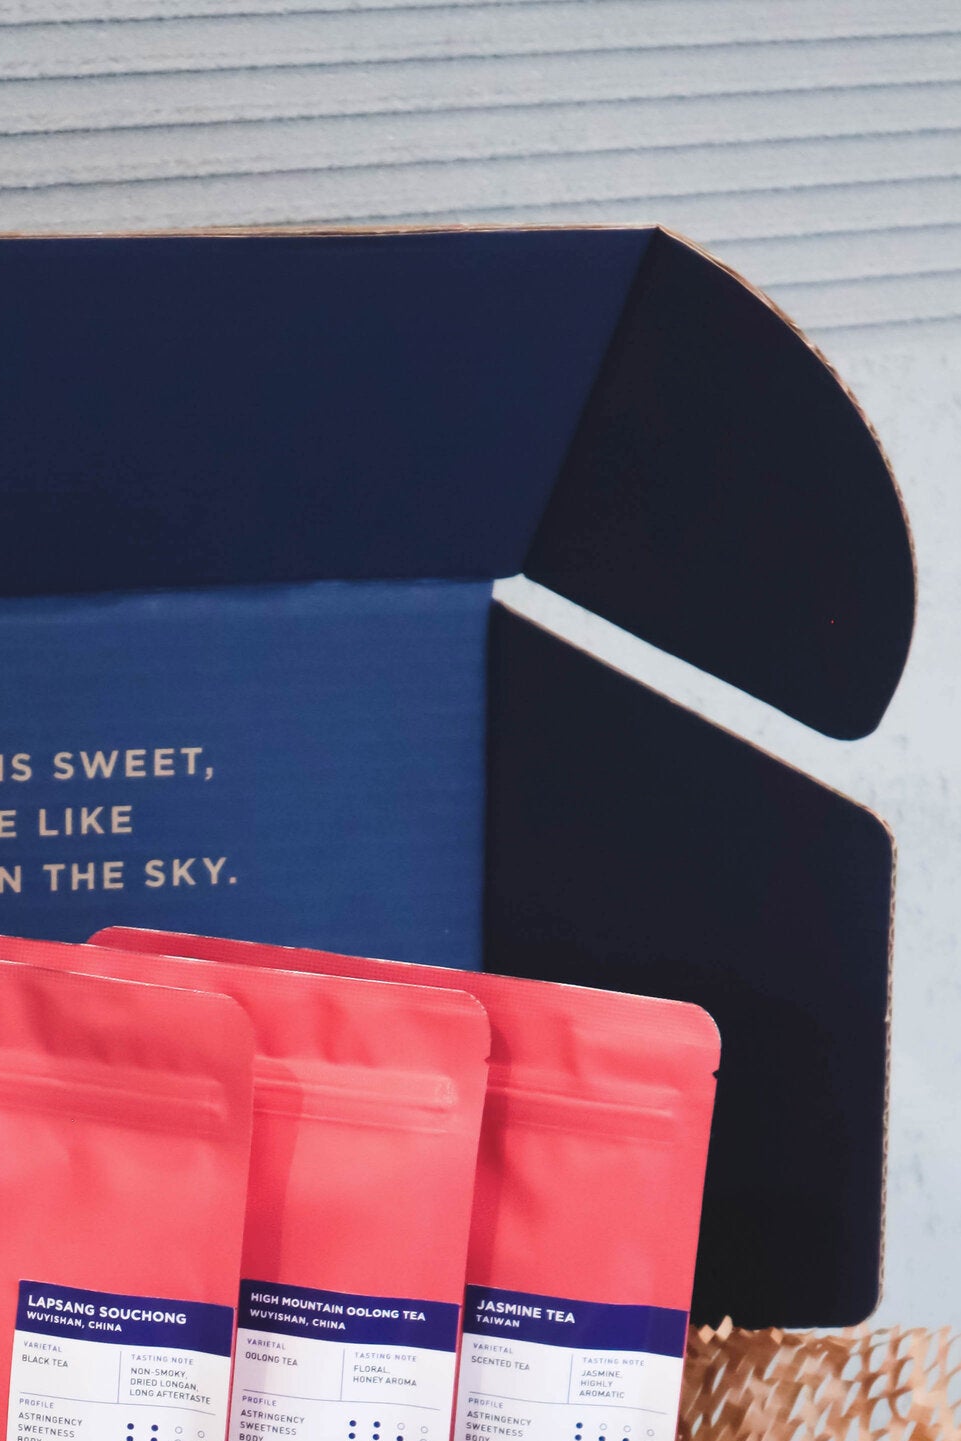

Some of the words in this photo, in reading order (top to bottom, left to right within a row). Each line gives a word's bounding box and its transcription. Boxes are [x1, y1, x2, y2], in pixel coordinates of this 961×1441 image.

[54, 747, 213, 781] SWEET,
[39, 805, 132, 836] LIKE
[43, 861, 124, 891] THE
[145, 857, 237, 887] SKY.
[28, 1295, 95, 1316] LAPSANG
[99, 1307, 187, 1325] SOUCHONG
[251, 1293, 279, 1305] HIGH
[282, 1297, 343, 1315] MOUNTAIN
[346, 1307, 399, 1319] OOLONG
[403, 1311, 426, 1321] TEA
[477, 1300, 542, 1319] JASMINE
[546, 1309, 575, 1323] TEA
[26, 1311, 85, 1329] WUYISHAN,
[88, 1321, 122, 1332] CHINA
[250, 1309, 309, 1327] WUYISHAN,
[312, 1318, 346, 1330] CHINA
[476, 1314, 520, 1328] TAIWAN
[23, 1341, 62, 1352] VARIETAL
[247, 1338, 286, 1350] VARIETAL
[473, 1343, 513, 1354] VARIETAL
[22, 1354, 50, 1365] BLACK
[52, 1358, 69, 1368] TEA
[131, 1354, 168, 1362] TASTING
[172, 1357, 194, 1365] NOTE
[246, 1352, 279, 1364] OOLONG
[282, 1357, 298, 1366] TEA
[355, 1352, 391, 1360] TASTING
[395, 1354, 417, 1362] NOTE
[471, 1355, 512, 1368] SCENTED
[514, 1361, 530, 1371] TEA
[622, 1359, 645, 1367] NOTE
[130, 1367, 187, 1380] NON-SMOKY,
[130, 1378, 157, 1387] DRIED
[160, 1380, 199, 1392] LONGAN,
[353, 1376, 383, 1384] HONEY
[385, 1377, 417, 1386] AROMA
[129, 1389, 154, 1397] LONG
[157, 1390, 211, 1405] AFTERTASTE
[242, 1396, 277, 1406] PROFILE
[579, 1390, 625, 1399] AROMATIC
[19, 1398, 54, 1409] PROFILE
[468, 1398, 504, 1409] PROFILE
[18, 1412, 83, 1427] ASTRINGENCY
[240, 1409, 305, 1424] ASTRINGENCY
[467, 1411, 531, 1426] ASTRINGENCY
[18, 1424, 75, 1438] SWEETNESS
[240, 1421, 297, 1435] SWEETNESS
[466, 1422, 524, 1437] SWEETNESS
